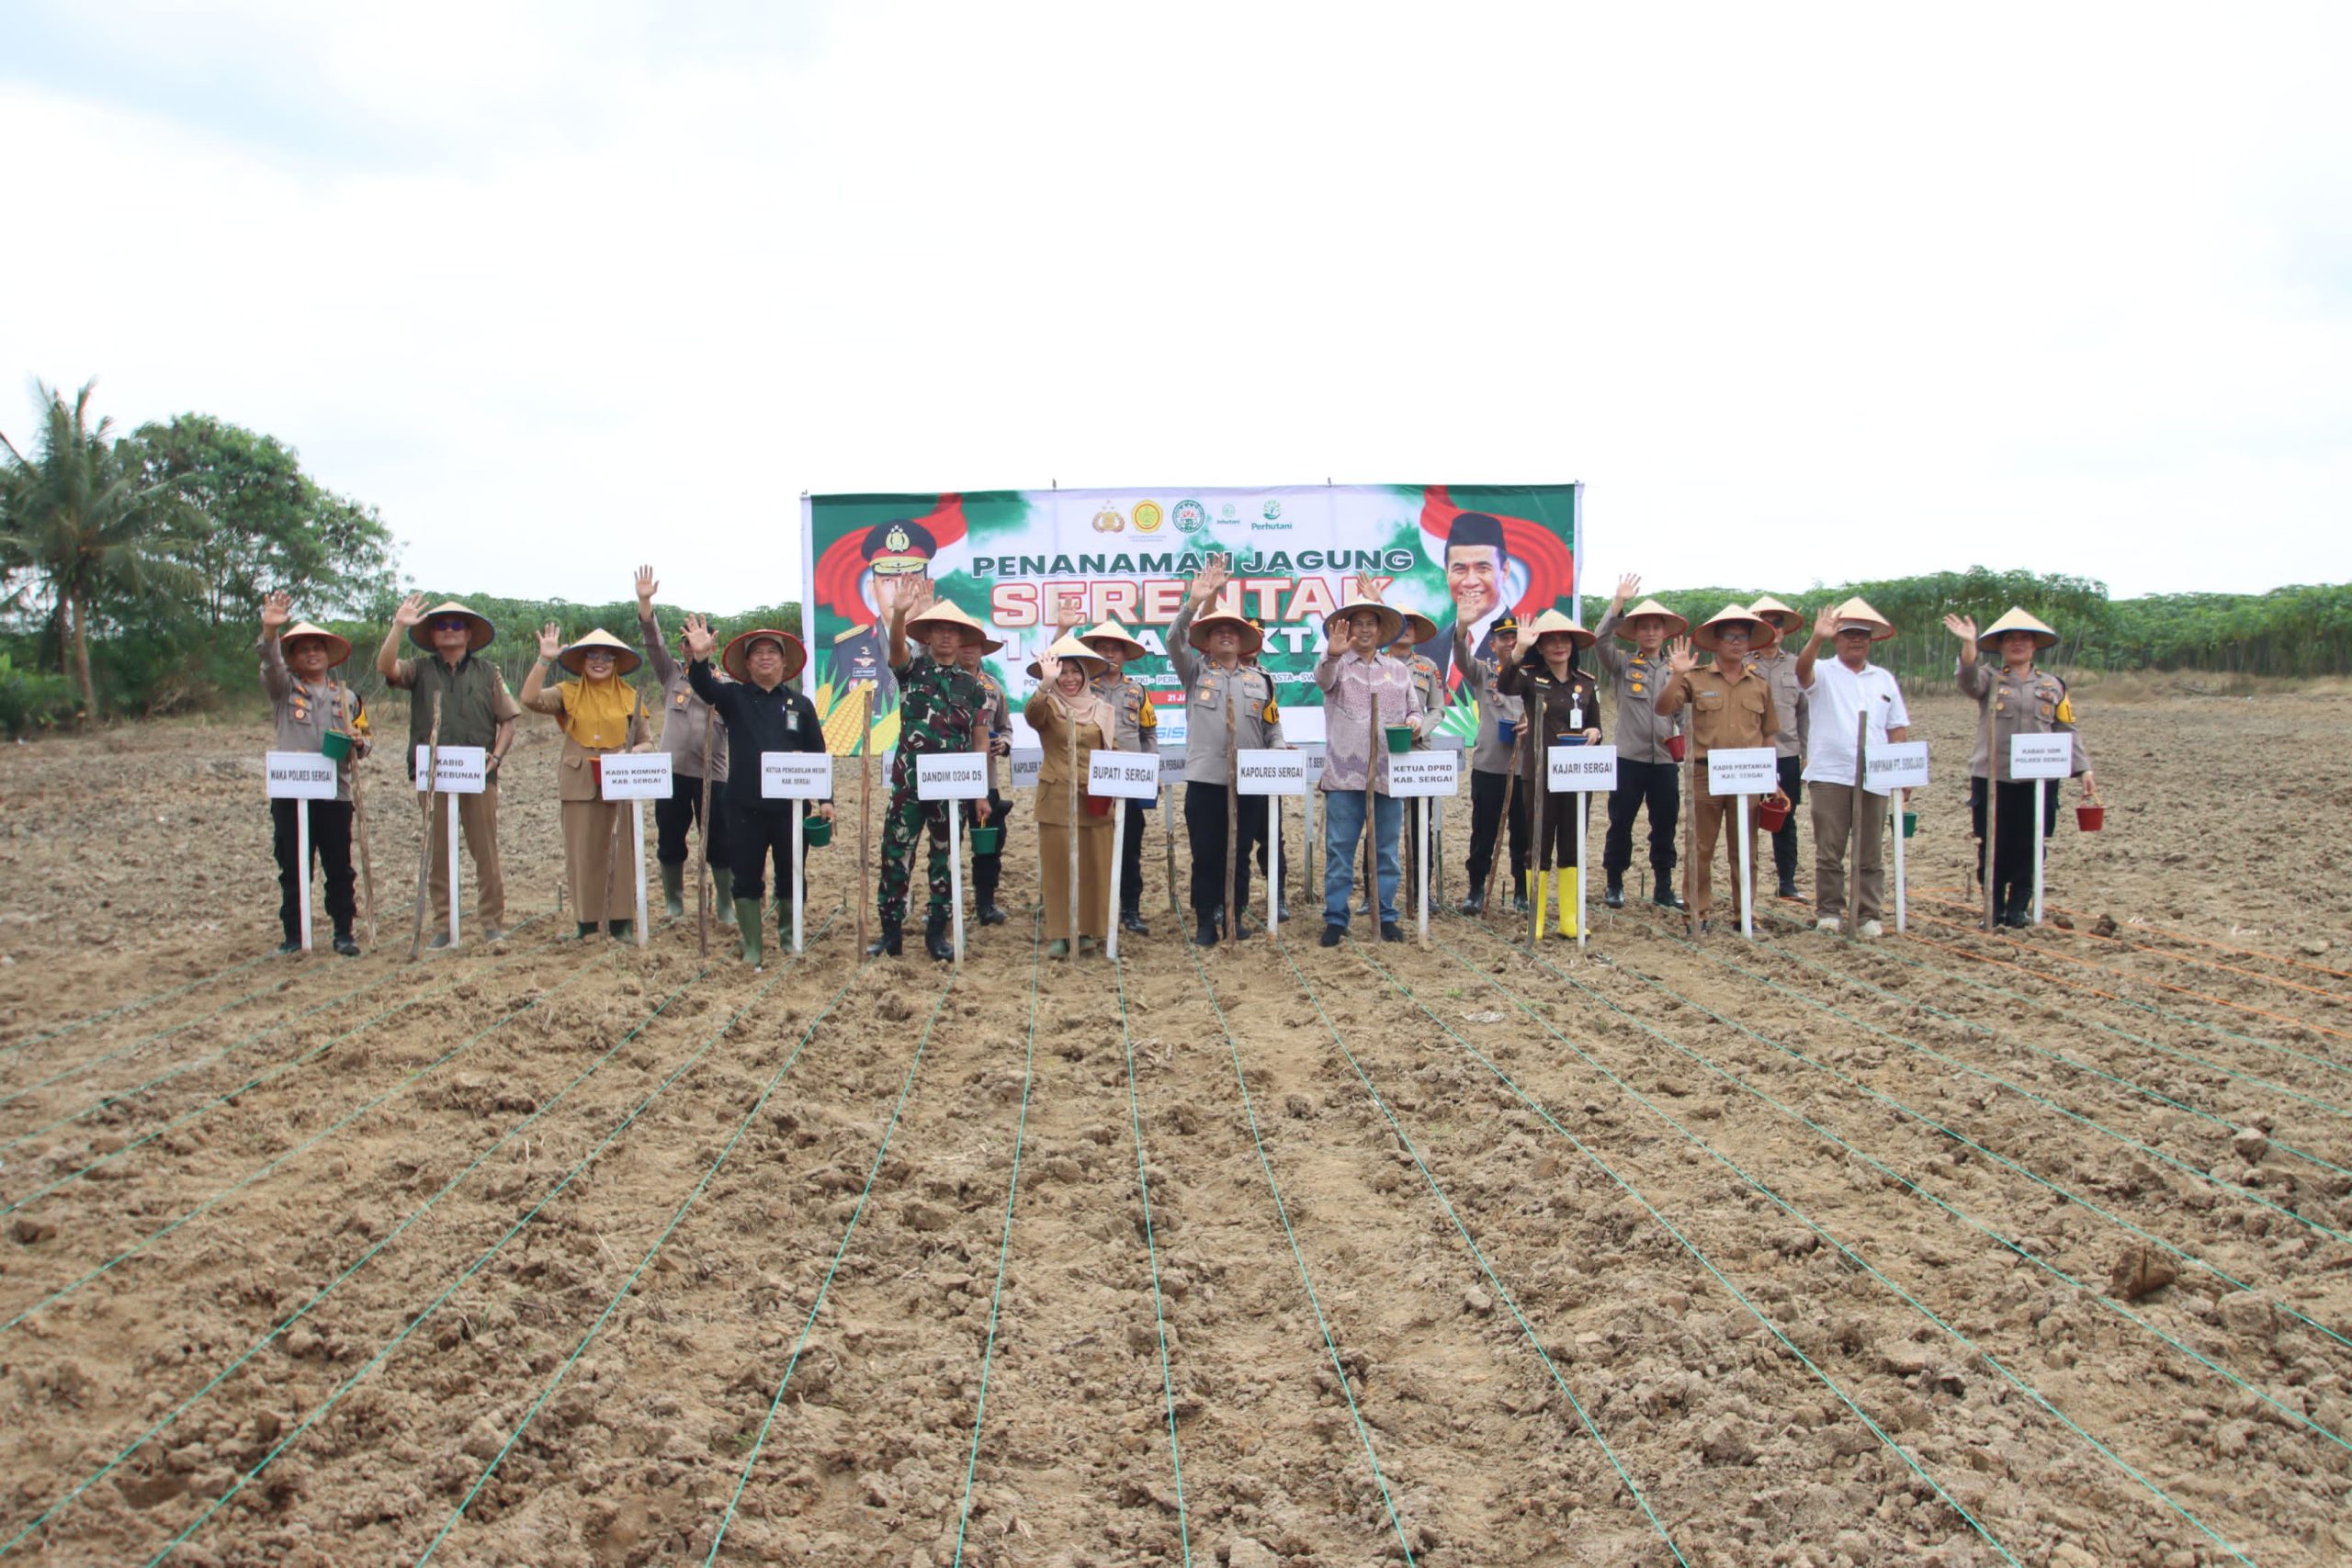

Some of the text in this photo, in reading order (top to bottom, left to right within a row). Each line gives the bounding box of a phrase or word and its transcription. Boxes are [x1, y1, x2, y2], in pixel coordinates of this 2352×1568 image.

[972, 549, 1413, 578] PENANAMAN JAGUNG
[436, 758, 464, 767] KABID
[1393, 764, 1424, 773] KETUA
[1552, 761, 1612, 774] KAJARI SERGAI
[271, 770, 332, 782] WAKA POLRES SERGAI
[419, 771, 481, 780] PEKEBUNAN
[922, 770, 982, 783] DANDIM 0204 DS
[1092, 766, 1154, 782] BUPATI SERGAI
[1240, 766, 1303, 779] KAPOLRES SERGAI
